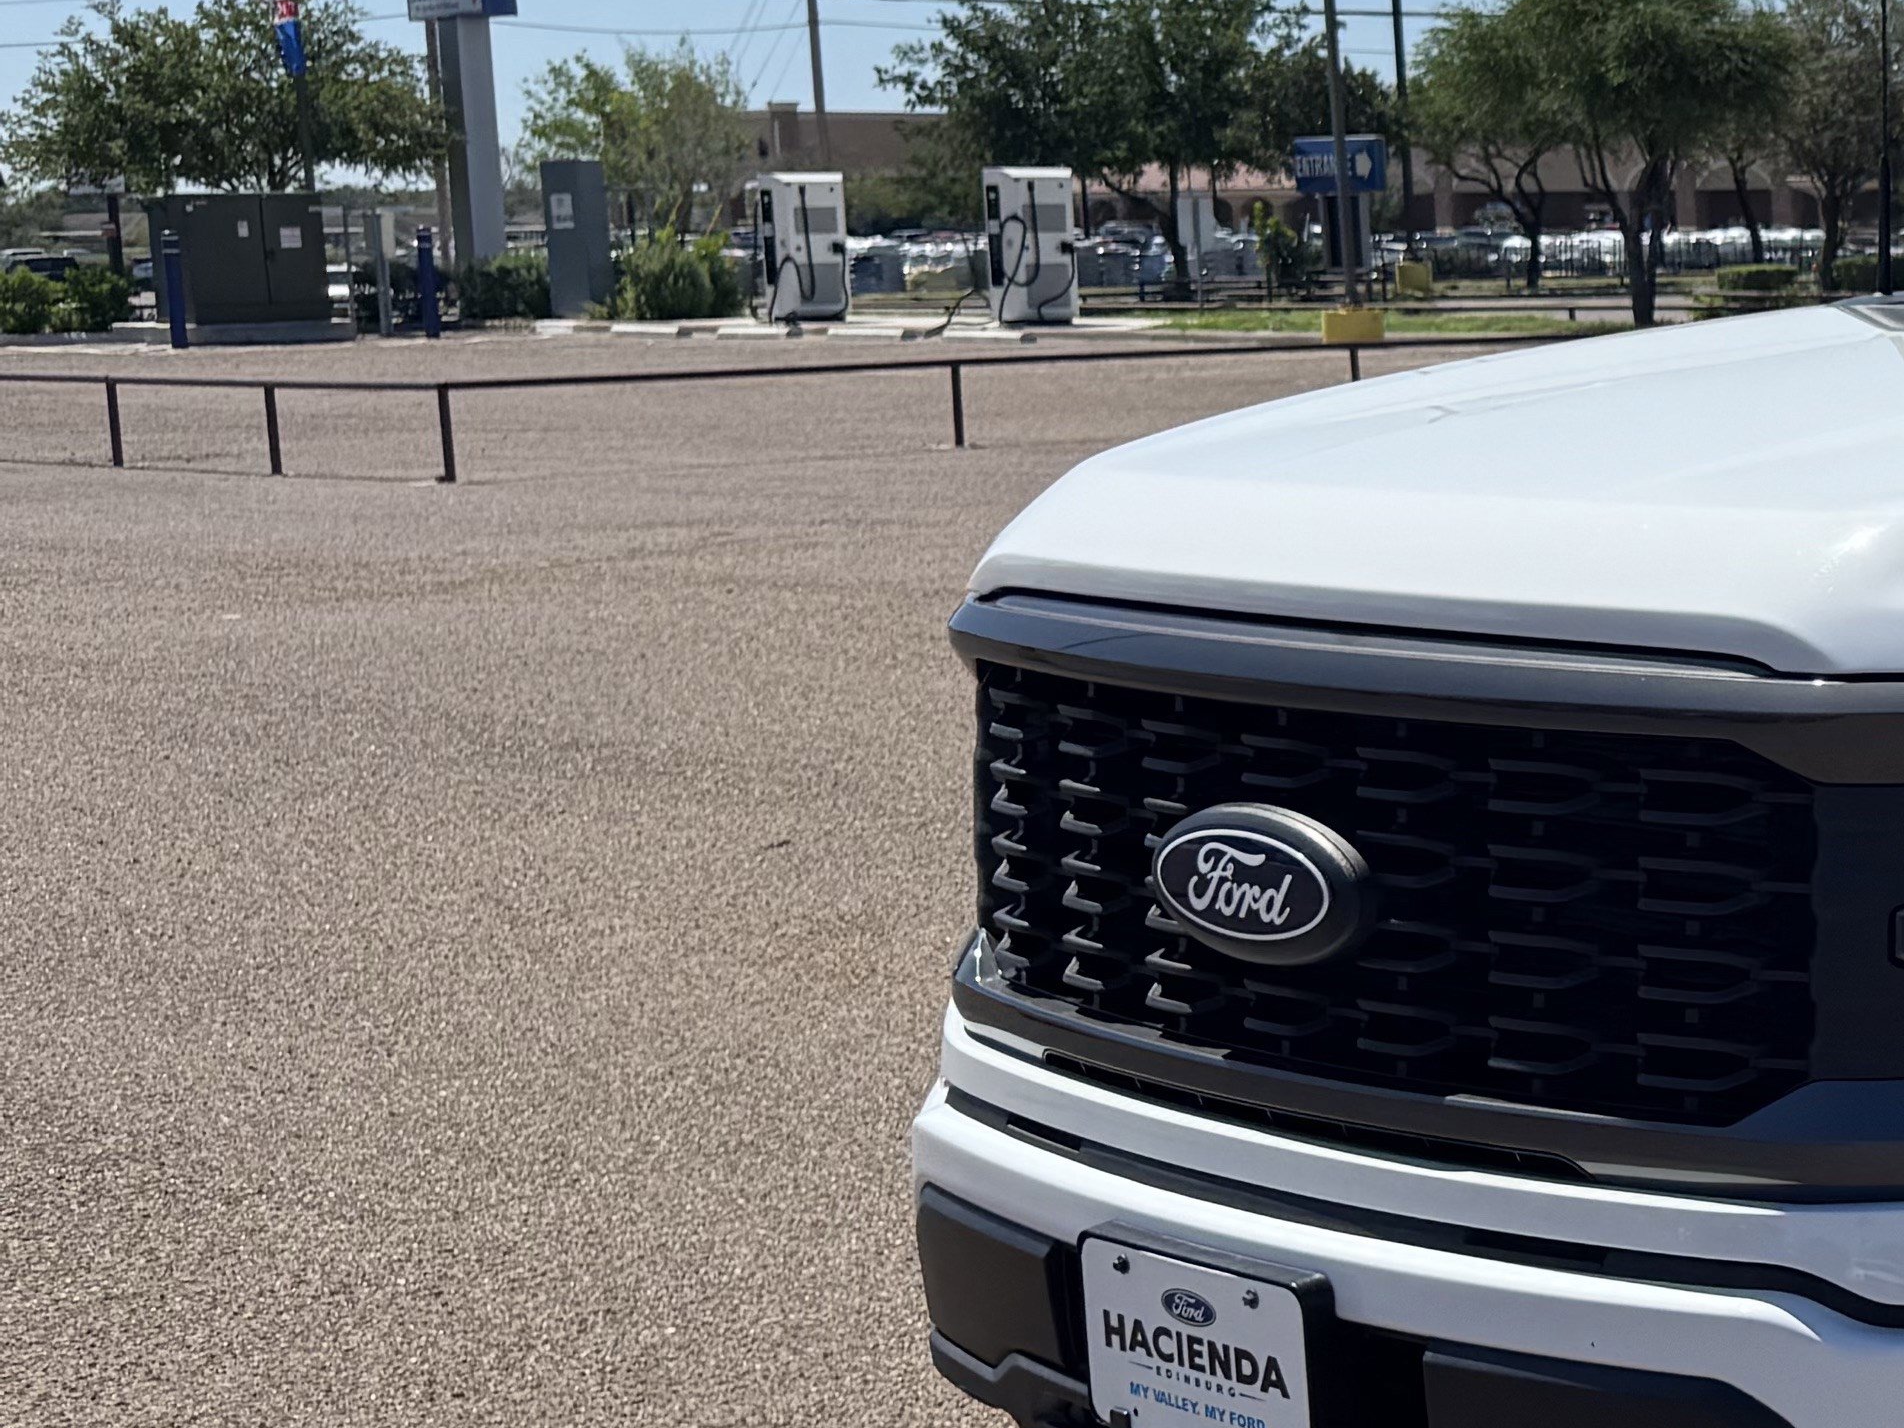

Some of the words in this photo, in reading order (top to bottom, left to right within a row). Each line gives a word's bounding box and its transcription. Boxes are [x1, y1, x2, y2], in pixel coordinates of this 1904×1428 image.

[1186, 840, 1293, 927] Ford
[1171, 1293, 1207, 1324] Ford
[1102, 1308, 1291, 1400] HACIENDA
[1129, 1380, 1150, 1400] MY
[1204, 1403, 1226, 1423] MY
[1155, 1364, 1237, 1398] EDINBURG
